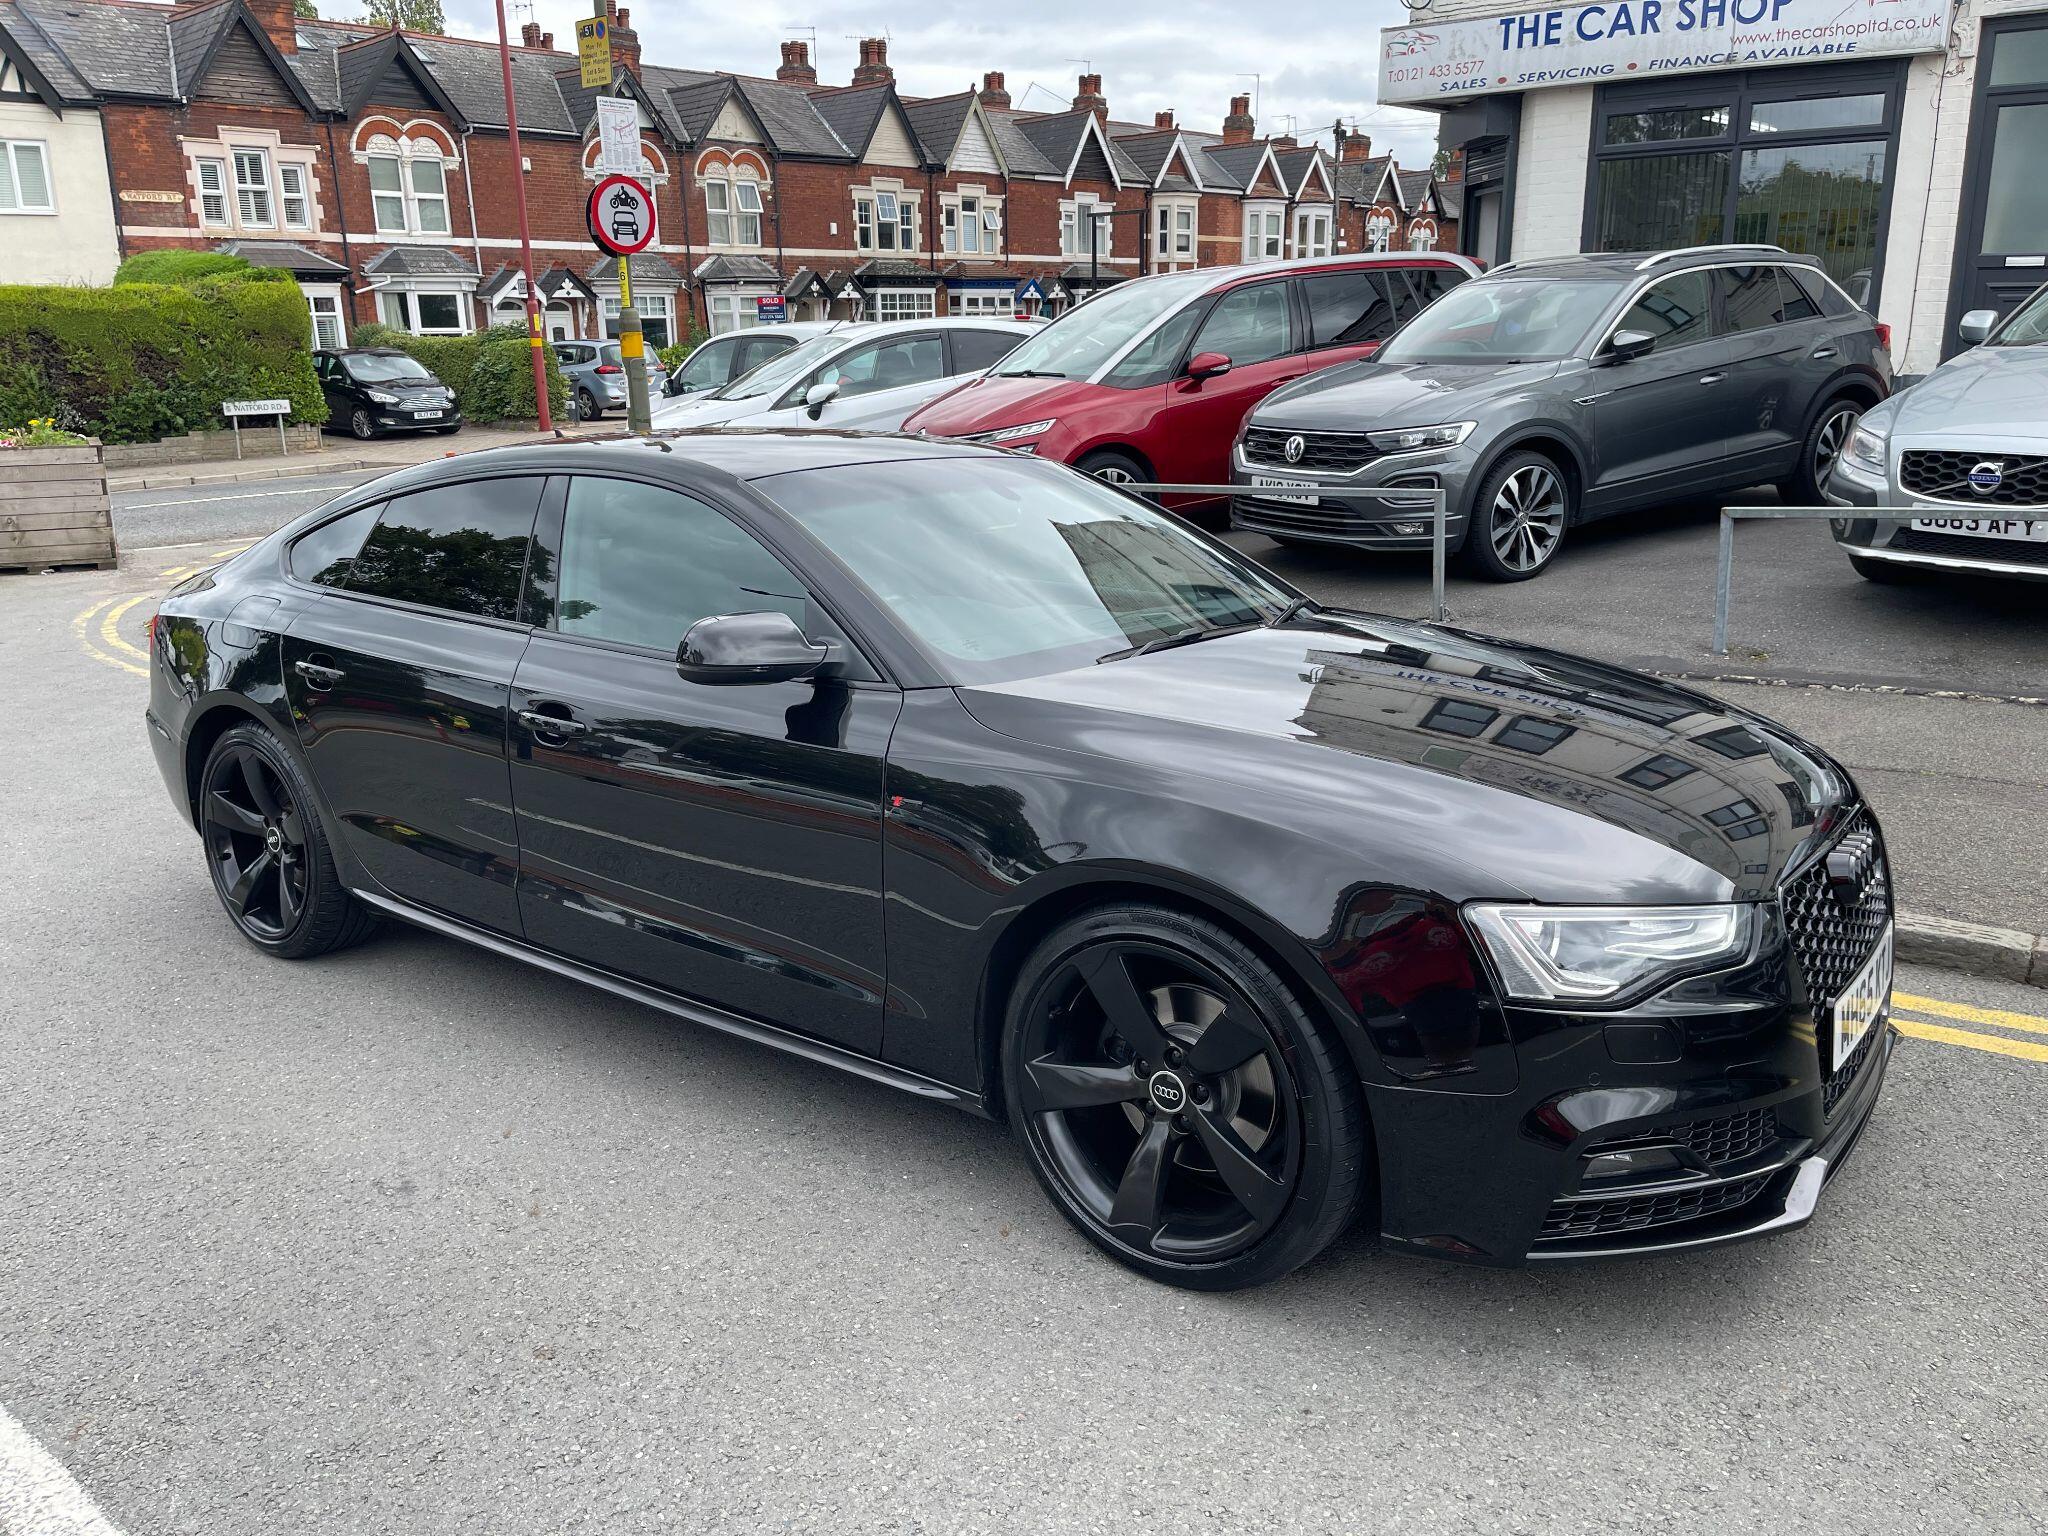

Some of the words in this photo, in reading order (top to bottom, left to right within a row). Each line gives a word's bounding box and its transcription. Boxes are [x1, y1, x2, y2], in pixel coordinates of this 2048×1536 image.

[1500, 11, 1563, 50] THE
[1576, 1, 1661, 41] CAR
[1676, 0, 1793, 31] SHOP
[1730, 13, 1942, 45] www.thecarshopltd.co.uk
[1649, 51, 1738, 70] FINANCE
[1743, 42, 1858, 61] AVAILABLE
[1388, 66, 1424, 83] T:0121
[1429, 64, 1450, 78] 433
[1454, 60, 1485, 76] 5577
[1439, 78, 1488, 92] SALES
[1517, 64, 1615, 84] SERVICING
[620, 271, 626, 281] 6
[233, 403, 270, 412] WATFORD
[271, 403, 282, 411] RD
[1970, 474, 2000, 482] VOLVO
